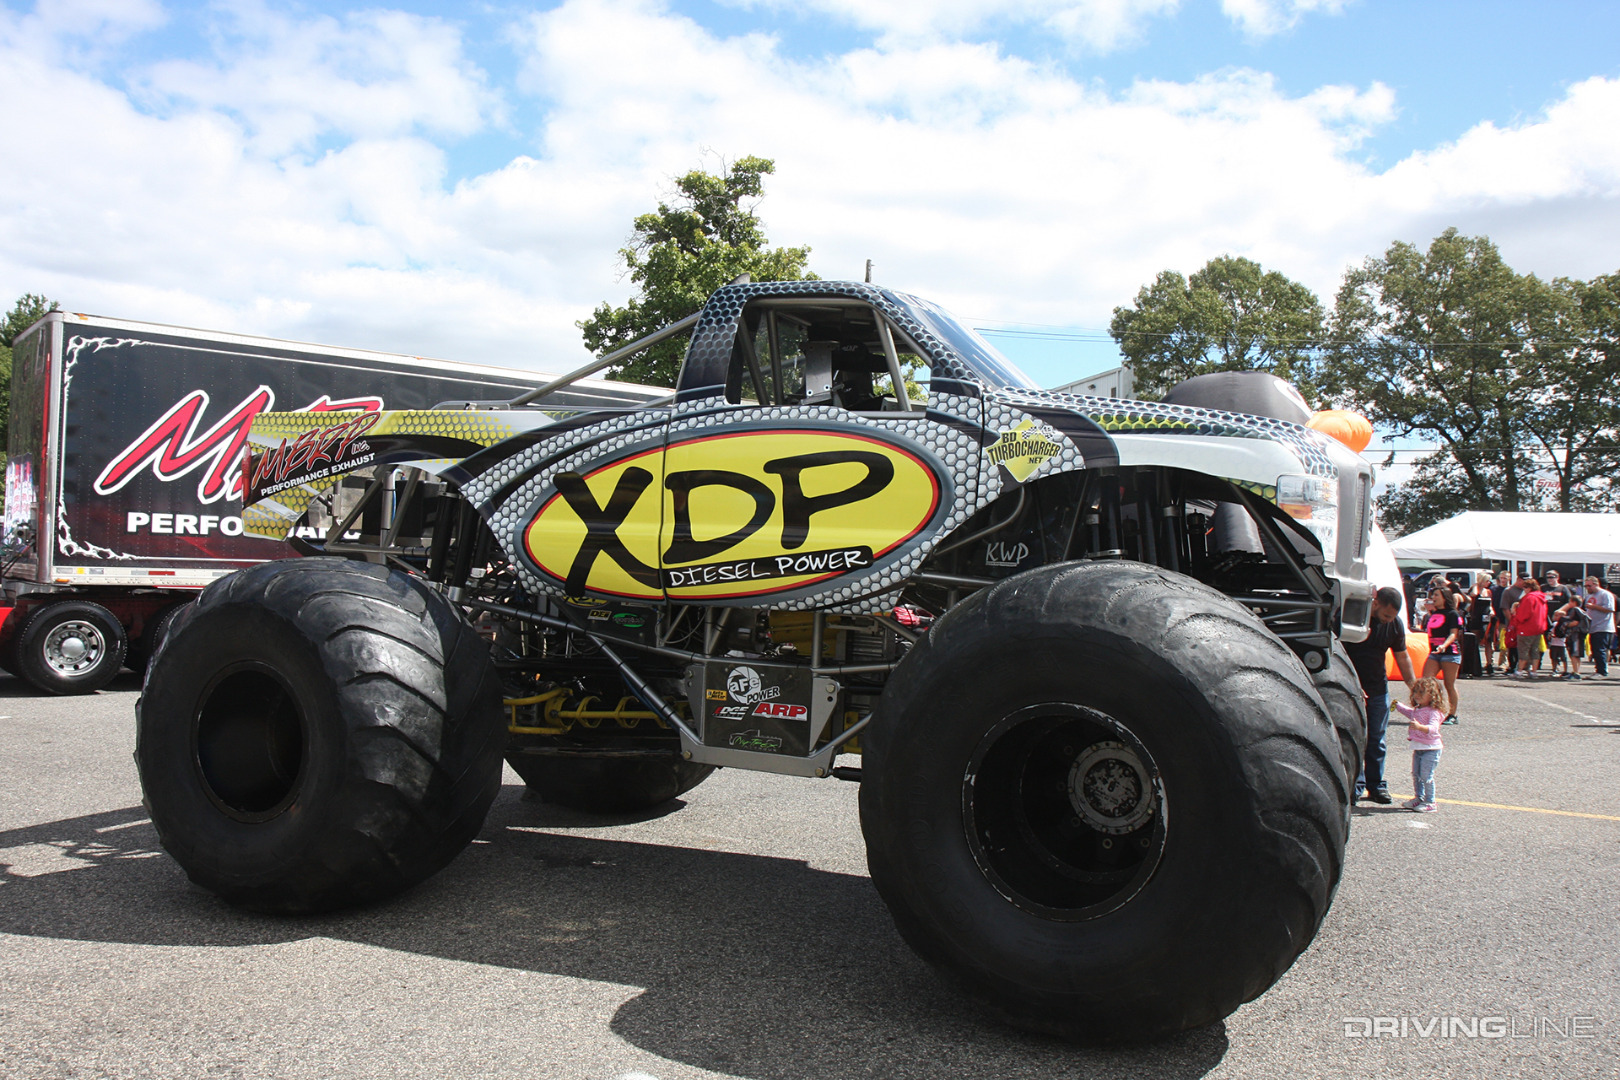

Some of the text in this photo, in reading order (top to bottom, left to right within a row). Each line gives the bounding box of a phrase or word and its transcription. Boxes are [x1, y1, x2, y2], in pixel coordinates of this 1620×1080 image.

[1001, 432, 1017, 443] BD
[251, 411, 381, 490] MBRP
[988, 440, 1061, 466] TURBOCHARGER
[261, 452, 376, 496] PERFORMANCE EXHAUST
[553, 451, 894, 596] XDP
[985, 541, 1029, 565] KWP
[669, 550, 868, 586] DIESEL POWER
[729, 677, 760, 692] aFe
[746, 686, 779, 704] POWER
[754, 703, 807, 717] ARP
